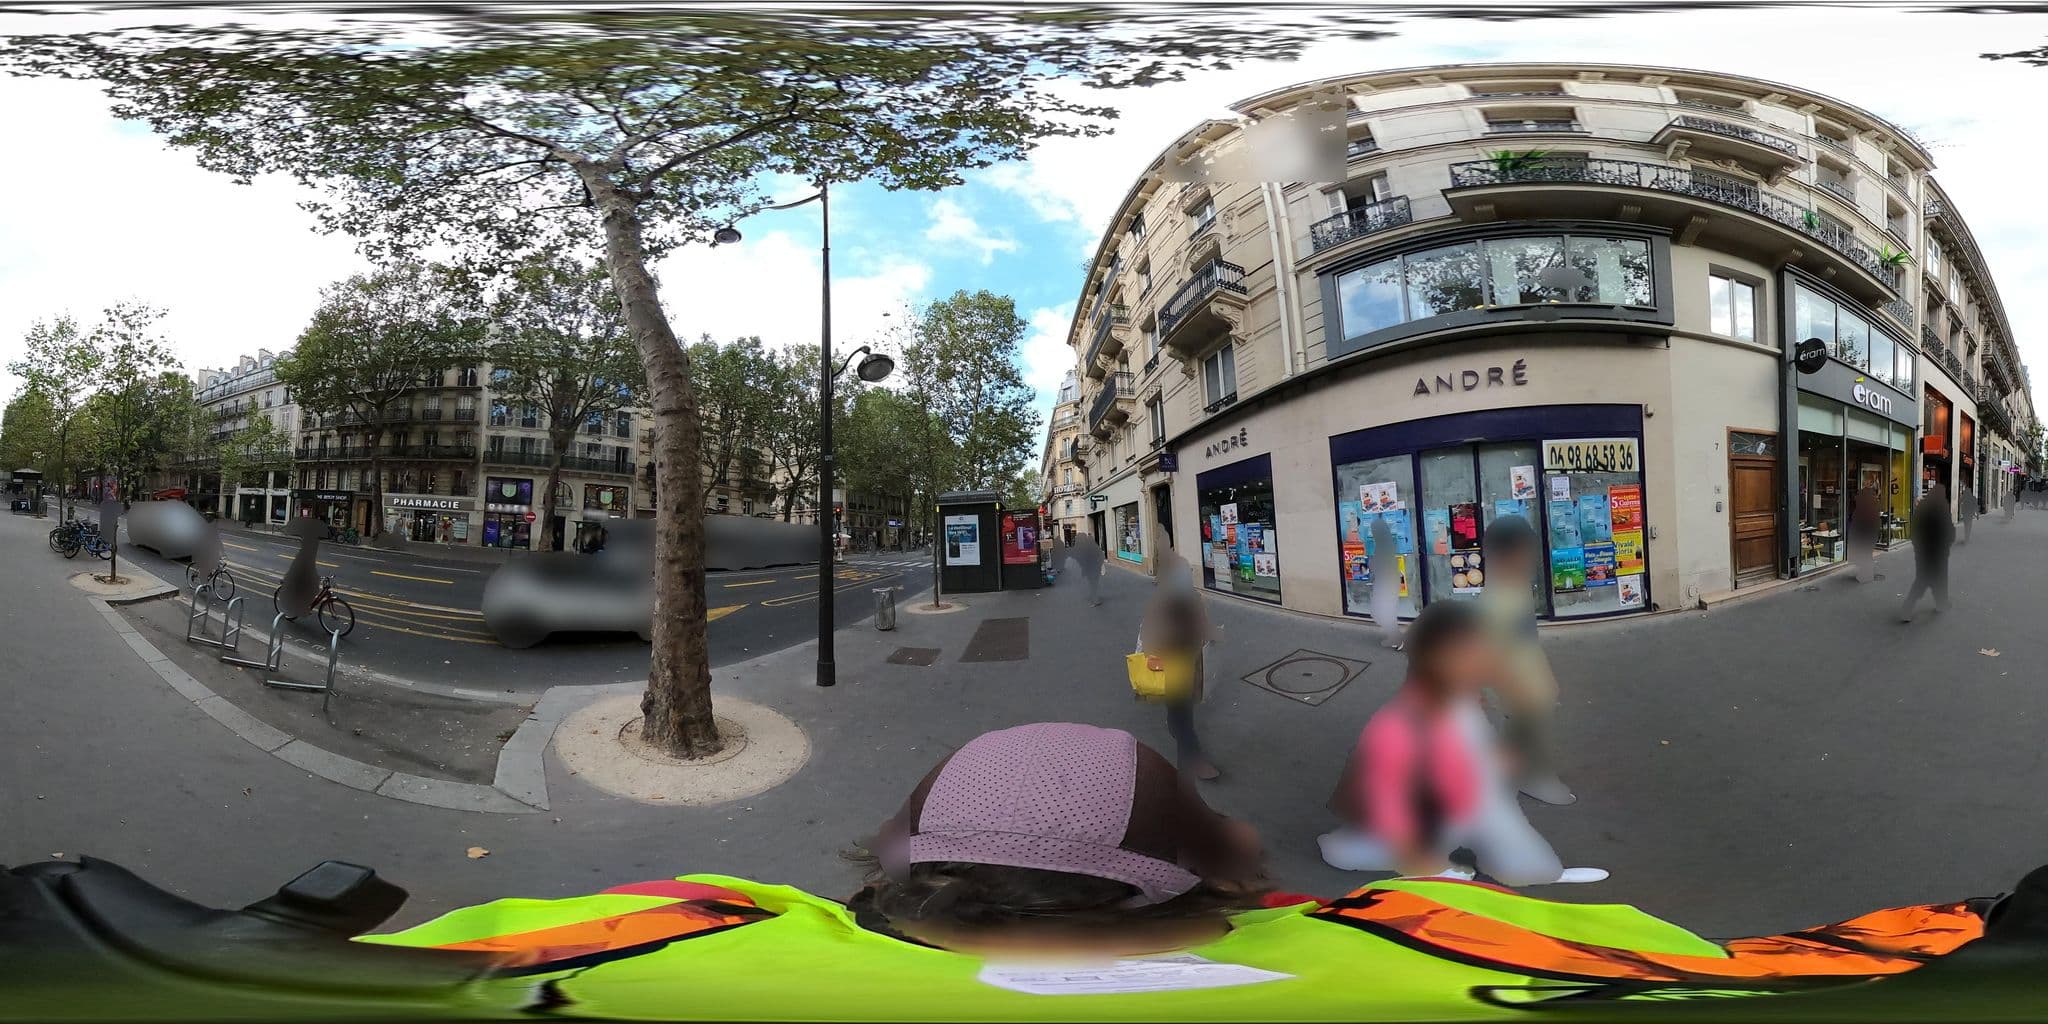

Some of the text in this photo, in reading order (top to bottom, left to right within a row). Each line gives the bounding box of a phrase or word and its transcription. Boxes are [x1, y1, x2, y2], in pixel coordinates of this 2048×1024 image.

[1799, 347, 1826, 361] éram
[1413, 358, 1529, 397] ANDRÉ
[1852, 375, 1892, 415] éram
[1205, 427, 1249, 459] ANDRÉ
[1585, 445, 1600, 472] 68
[1603, 443, 1617, 471] 58
[1619, 443, 1633, 471] 36
[393, 498, 460, 509] PHARMACIE
[1611, 496, 1619, 509] 5
